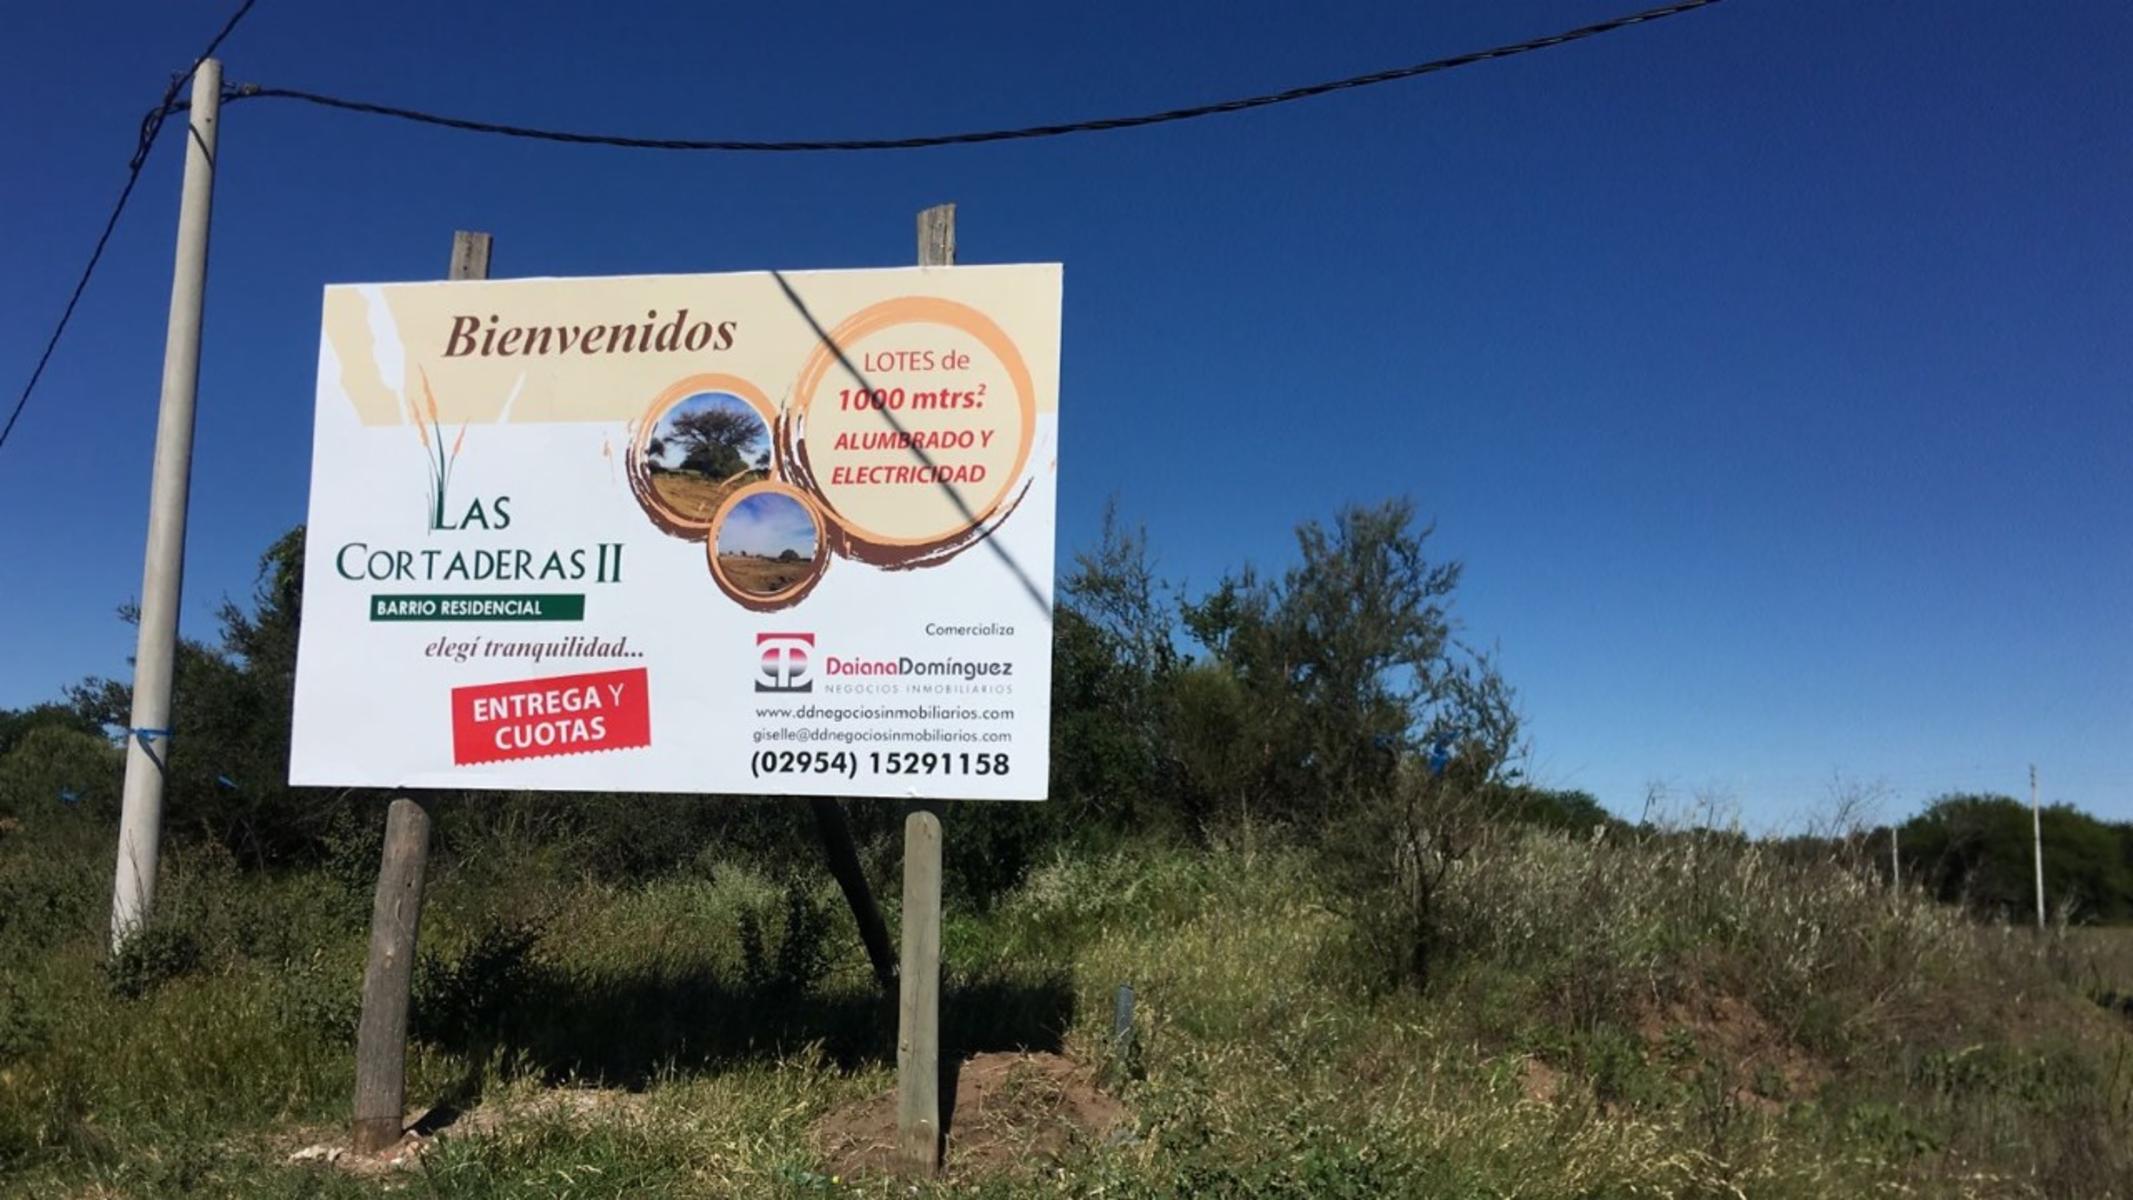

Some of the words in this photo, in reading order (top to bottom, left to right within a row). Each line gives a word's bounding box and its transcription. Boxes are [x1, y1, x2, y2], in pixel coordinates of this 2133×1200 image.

[441, 306, 738, 358] Bienvenidos
[864, 350, 935, 372] LOTES
[941, 350, 970, 370] de
[839, 387, 904, 411] 1000
[834, 430, 974, 451] ALUMBRADO
[980, 430, 994, 448] Y
[831, 465, 986, 485] ELECTRICIDAD
[433, 496, 511, 530] LAS
[336, 543, 586, 581] CORTADERAS
[595, 543, 626, 583] II
[377, 601, 436, 615] BARRIO
[441, 601, 542, 615] RESIDENCIAL
[925, 623, 1015, 636] Comercializa
[425, 637, 480, 663] elegí
[484, 636, 644, 663] tranquilidad...
[826, 657, 1013, 680] DaianaDomínguez
[825, 684, 899, 694] NEGOCIOS
[906, 684, 1013, 694] INMOBILIARIOS
[473, 686, 602, 722] ENTREGA
[608, 683, 625, 707] Y
[756, 704, 1015, 723] www.ddnegociosinmobiliarios.com
[495, 716, 607, 750] CUOTAS
[753, 728, 1013, 744] giselle@ddnegociosinmobiliarios.com
[751, 751, 858, 779] (02954)
[870, 751, 1010, 775] 15291158
